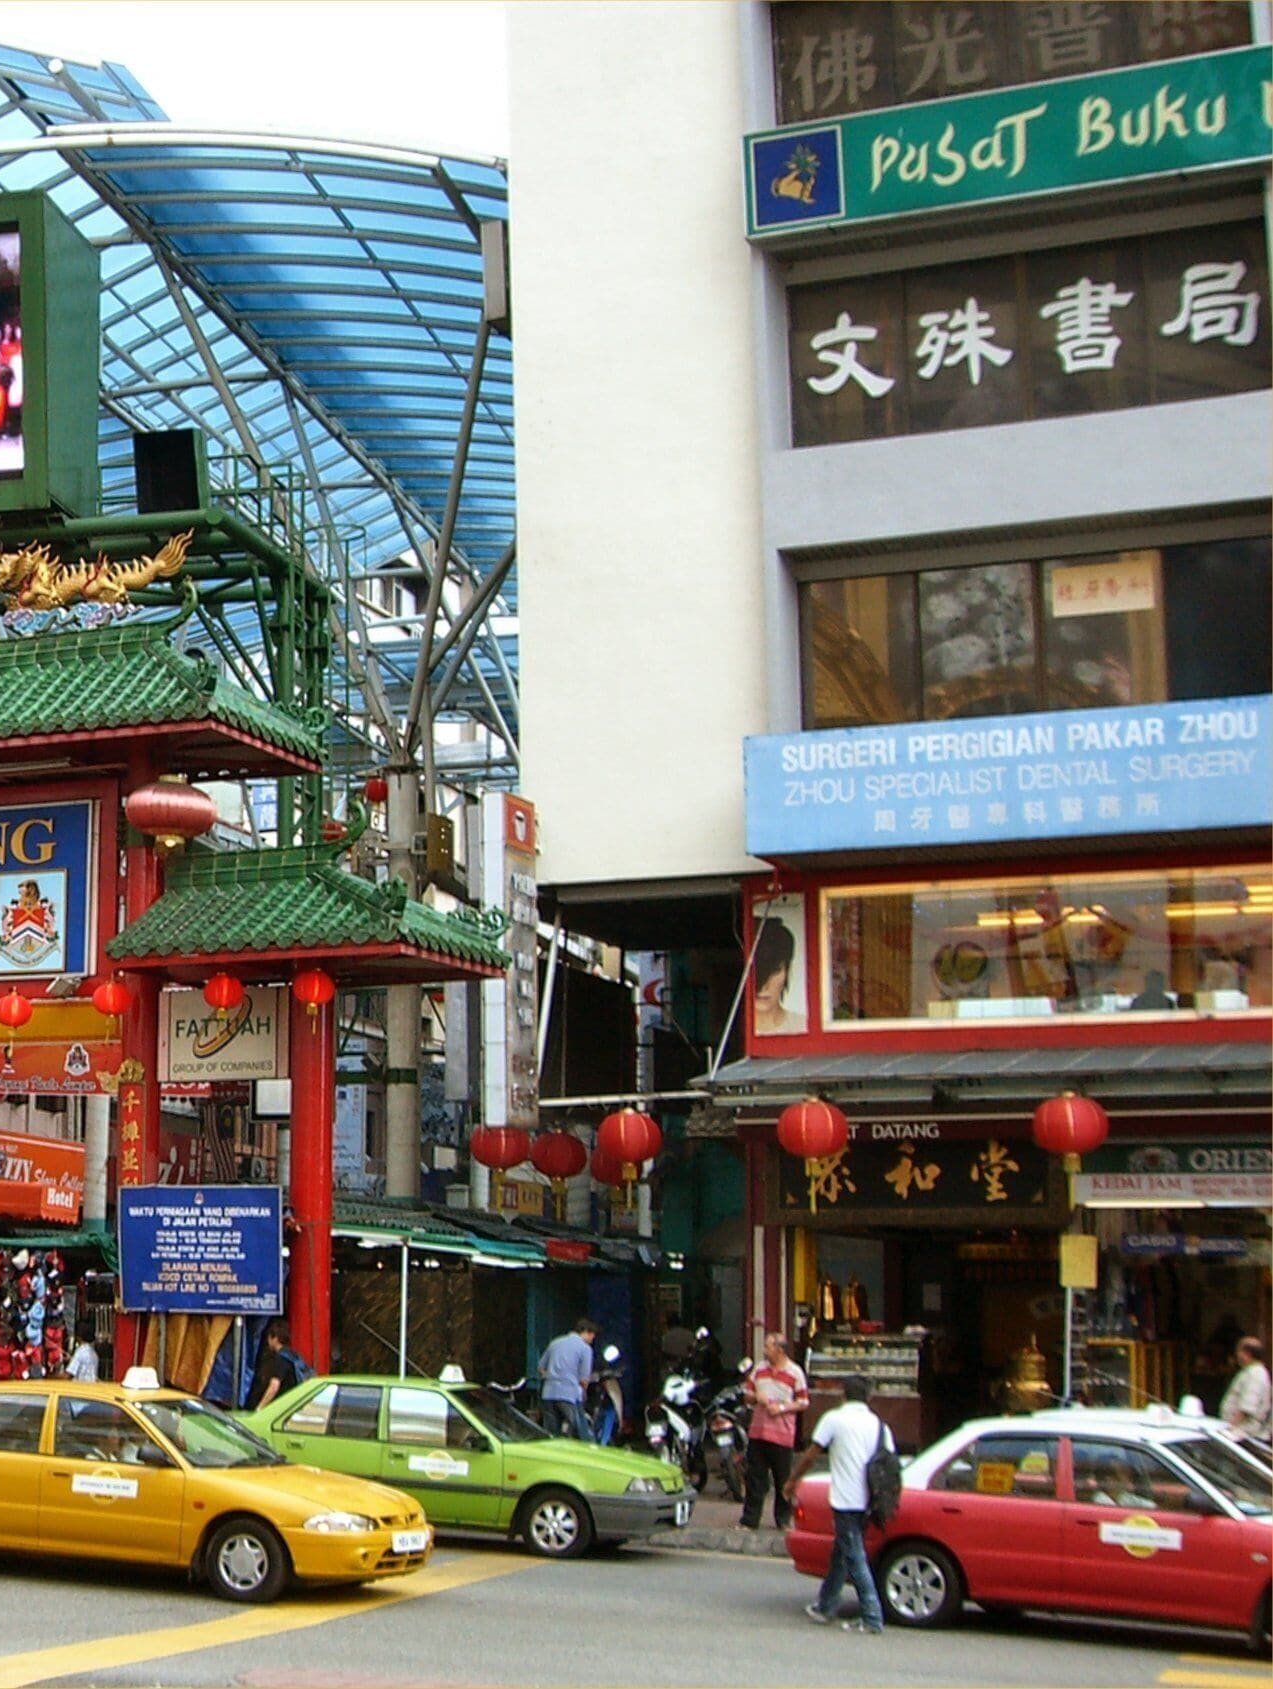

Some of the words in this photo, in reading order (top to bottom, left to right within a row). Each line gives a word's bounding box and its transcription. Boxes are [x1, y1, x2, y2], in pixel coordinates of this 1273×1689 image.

[805, 260, 1261, 400] 文殊書局
[781, 737, 897, 774] SURGERI
[907, 725, 1055, 764] PERGIGIAN
[1066, 717, 1166, 752] PAKAR
[1178, 709, 1259, 745] ZHOU
[783, 776, 856, 807] ZHOU
[863, 766, 1007, 802] SPECIALIST
[1016, 760, 1118, 791] DENTAL
[1128, 749, 1258, 783] SURGERY
[172, 1063, 204, 1074] GROUP
[205, 1063, 217, 1073] OF
[220, 1060, 274, 1072] COMPANIES
[871, 1122, 941, 1140] DATANG
[46, 1187, 75, 1208] Hotel
